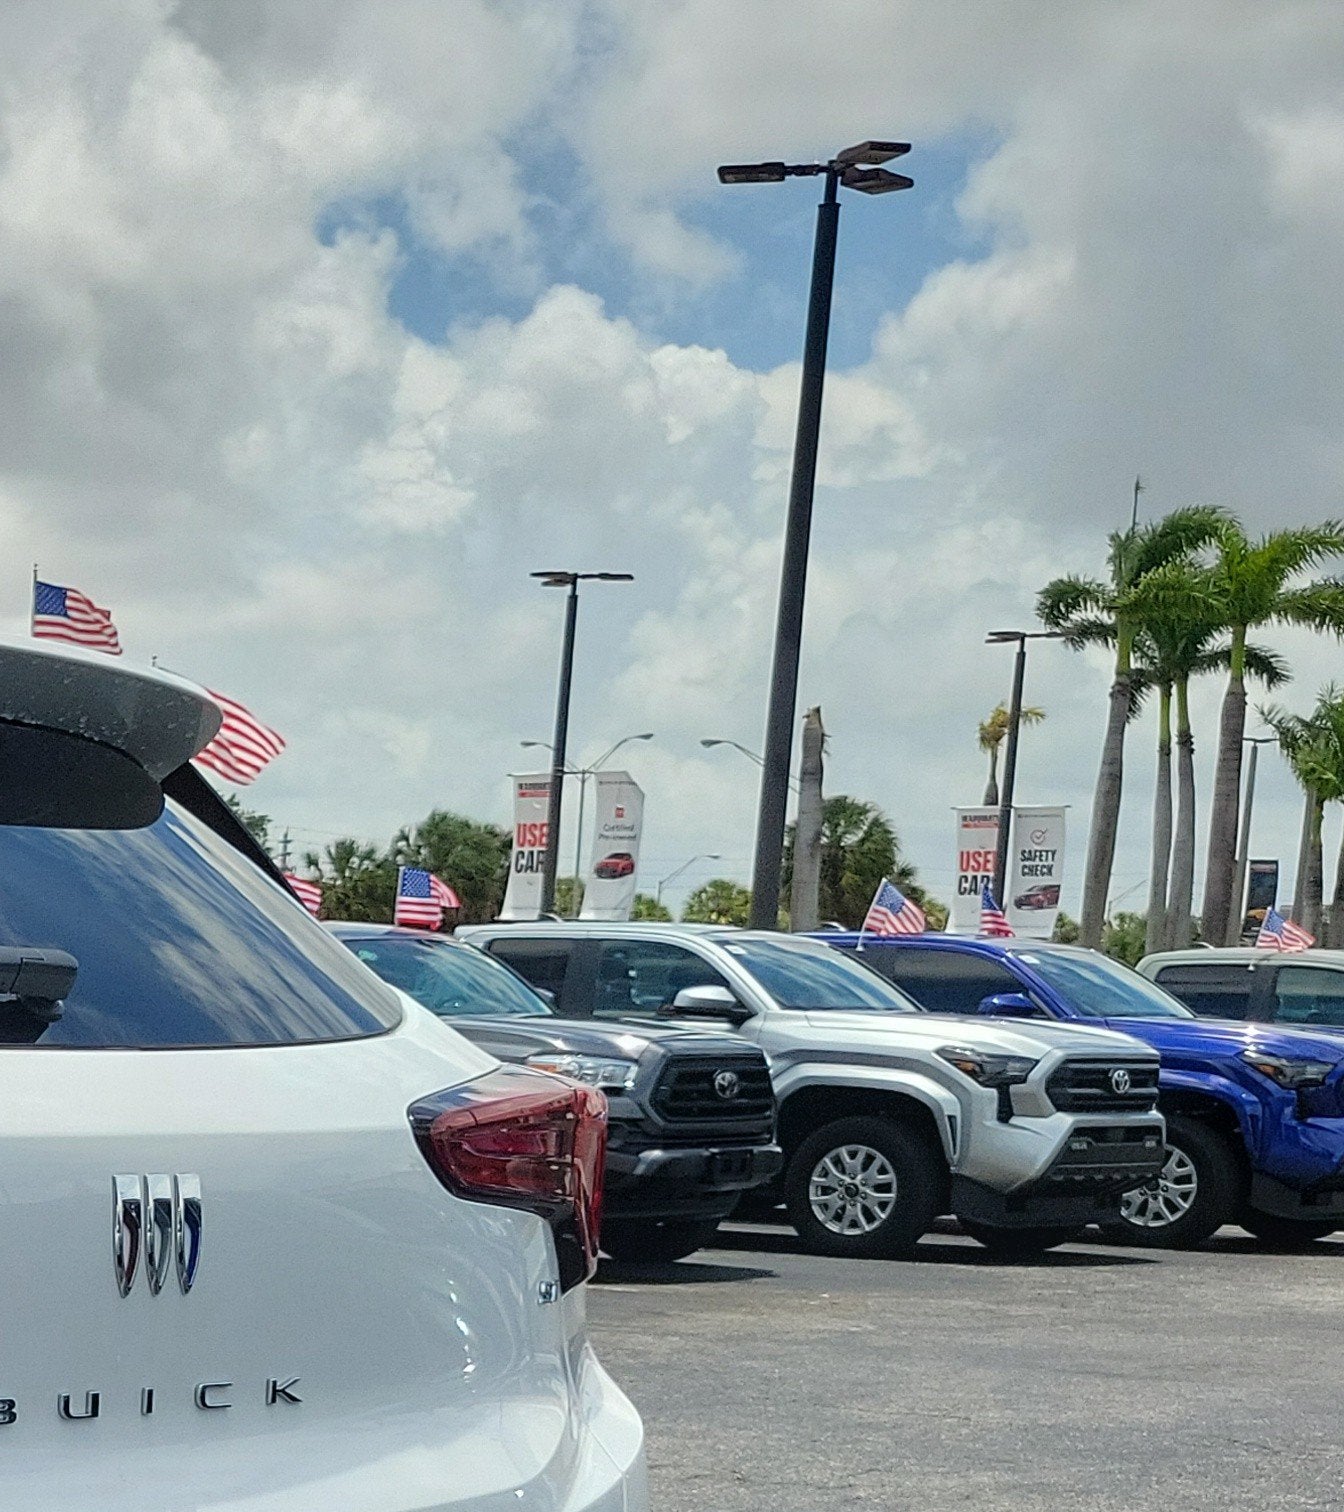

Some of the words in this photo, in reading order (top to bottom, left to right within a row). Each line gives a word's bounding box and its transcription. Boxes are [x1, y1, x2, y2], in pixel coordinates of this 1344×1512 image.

[517, 823, 549, 848] USE
[960, 851, 994, 872] USE
[1020, 849, 1057, 862] SAFETY
[1021, 864, 1054, 877] CHECK
